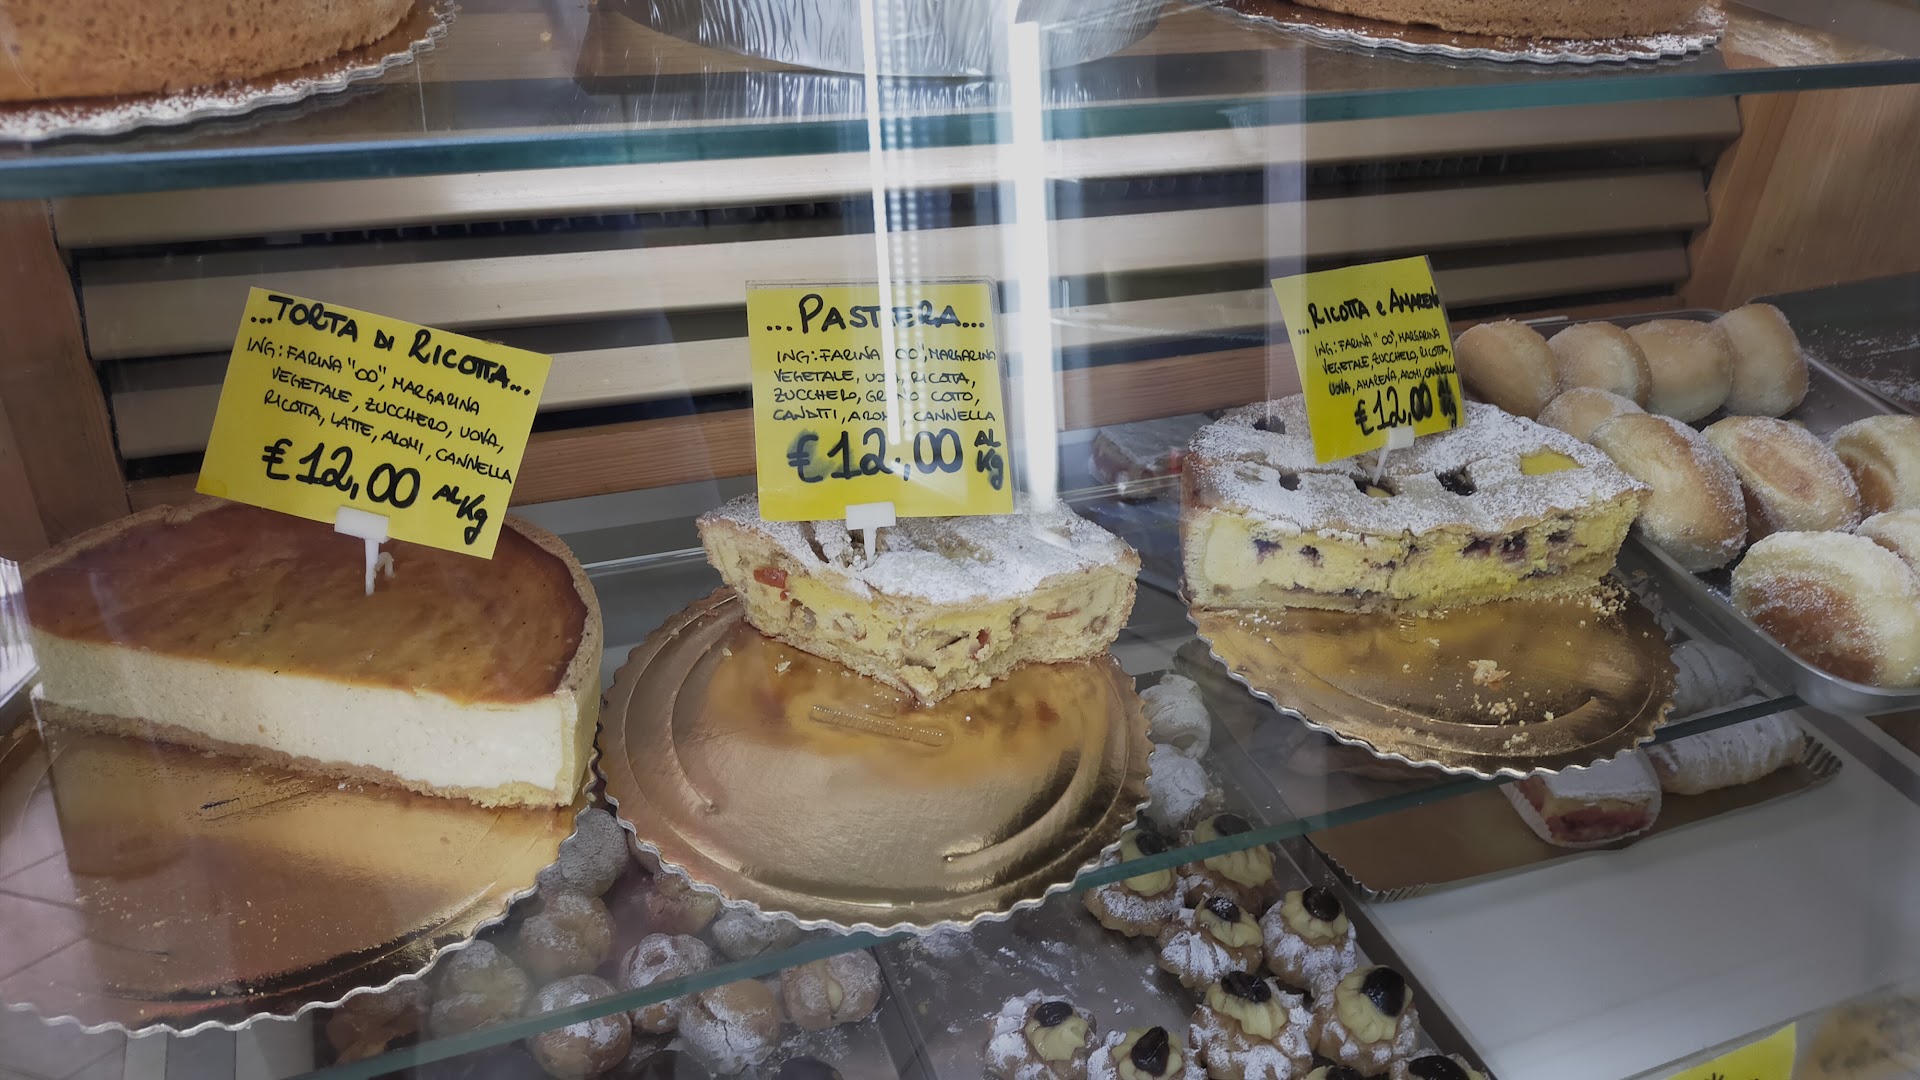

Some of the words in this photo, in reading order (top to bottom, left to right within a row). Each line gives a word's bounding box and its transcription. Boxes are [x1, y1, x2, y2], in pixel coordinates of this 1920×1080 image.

[374, 329, 395, 351] DI
[1398, 327, 1440, 342] MARGARINA
[928, 347, 996, 362] MARGARINA
[392, 377, 480, 415] MARGARINA
[913, 407, 996, 421] CANNELLA
[264, 389, 326, 427] RICOTTA,
[436, 448, 513, 484] CANNELLA
